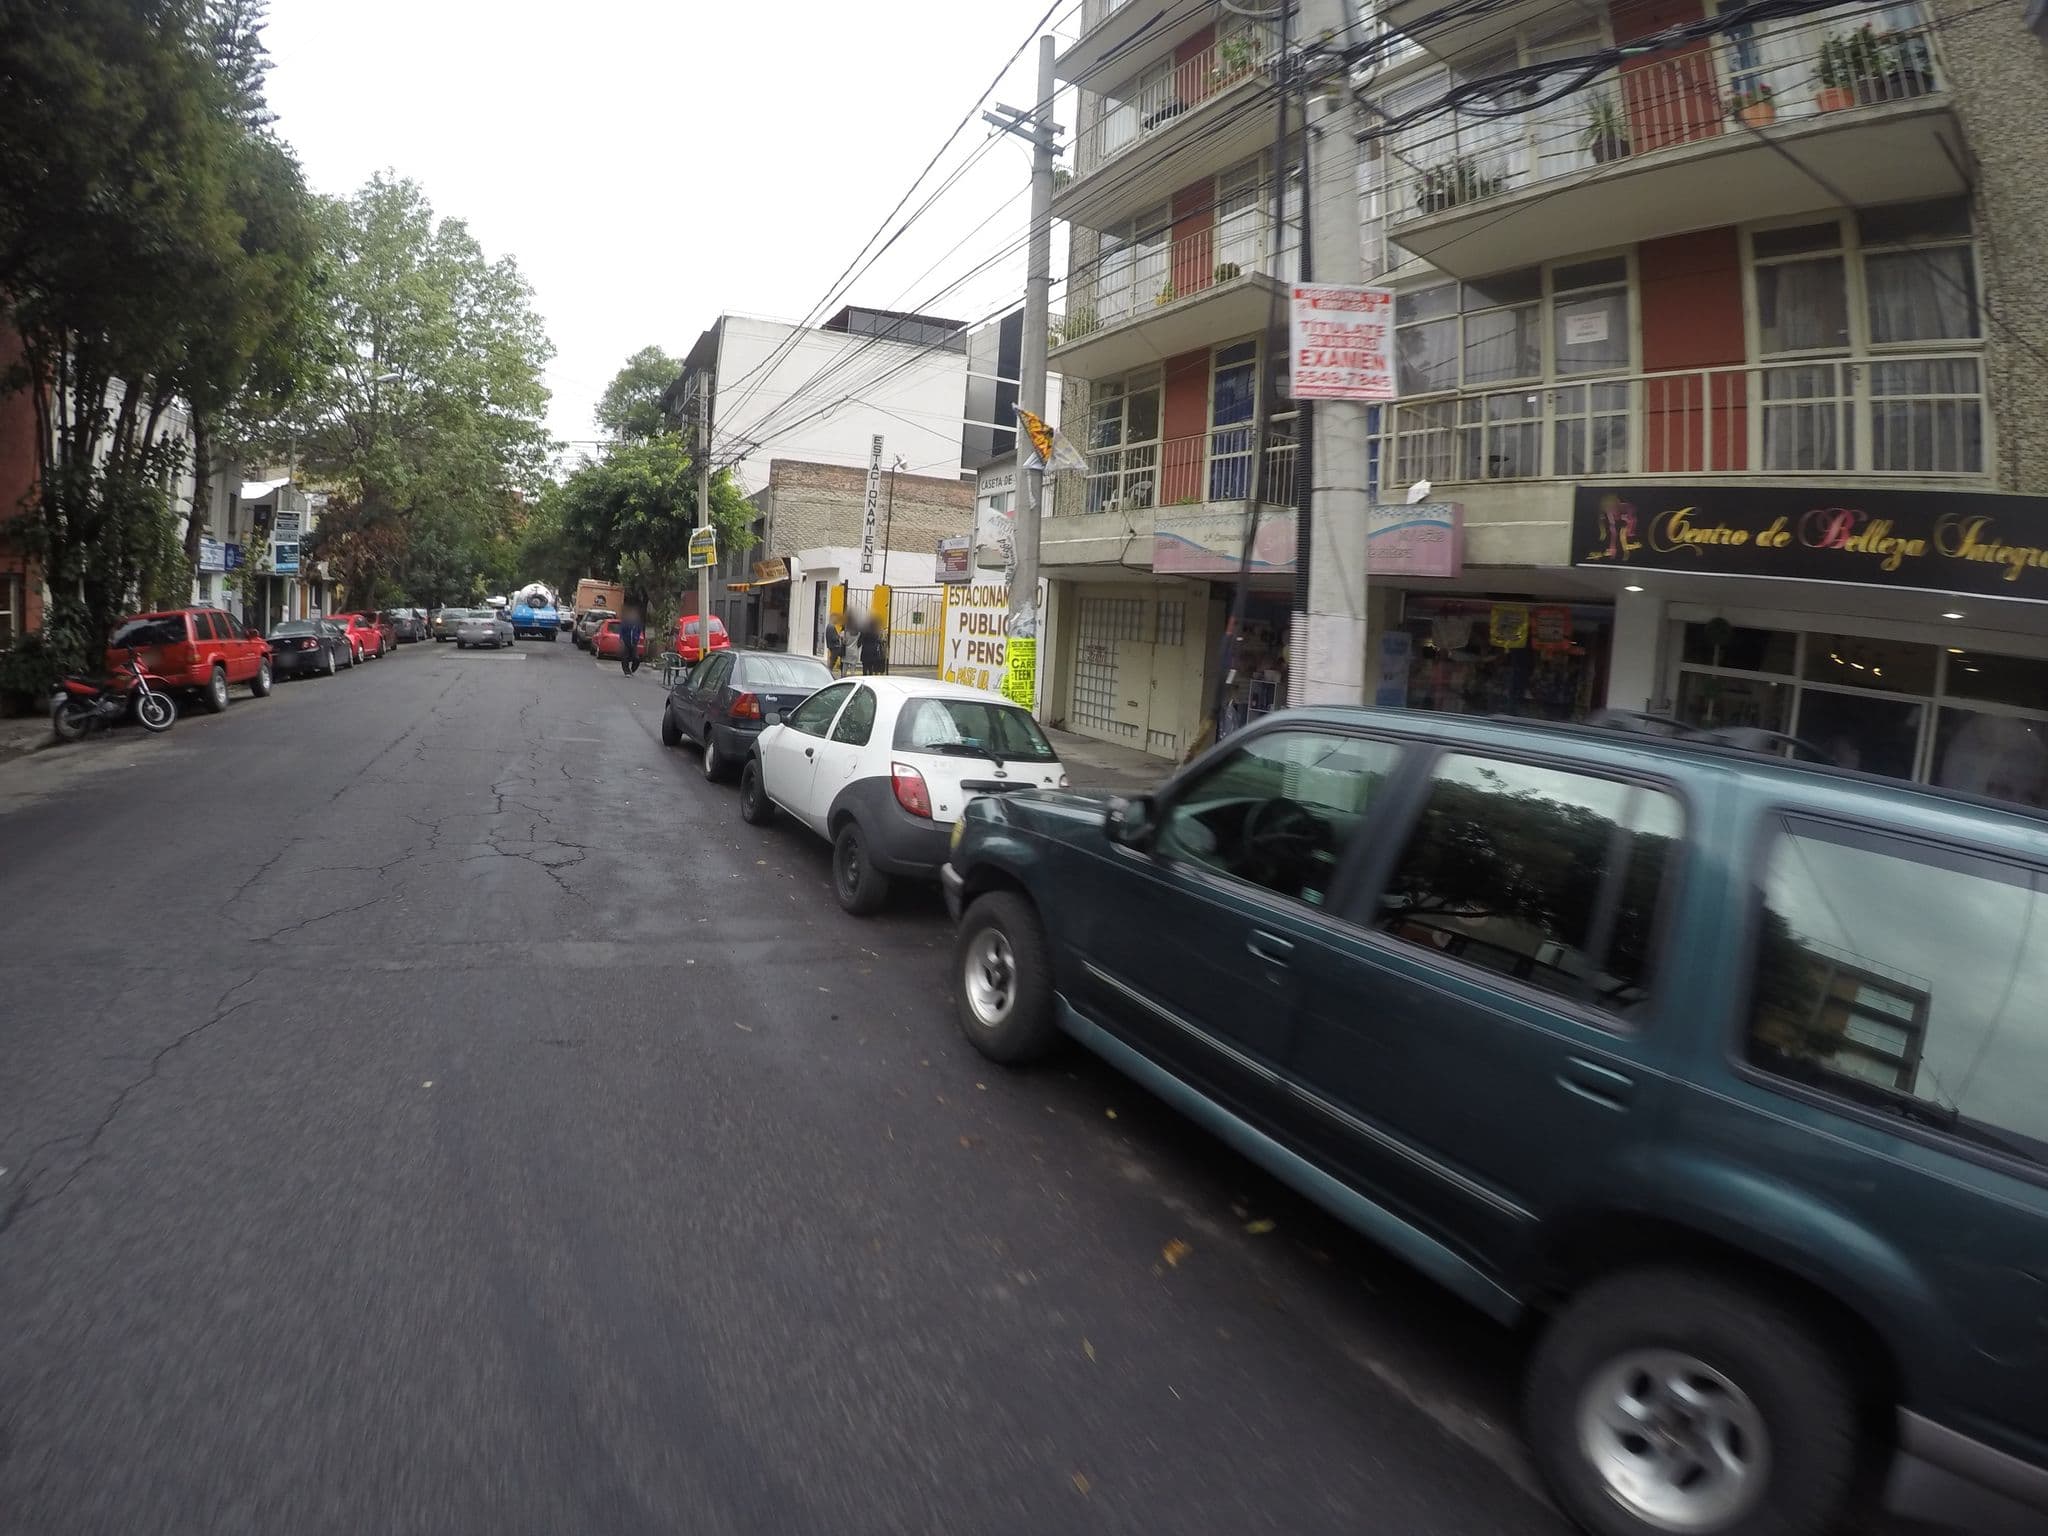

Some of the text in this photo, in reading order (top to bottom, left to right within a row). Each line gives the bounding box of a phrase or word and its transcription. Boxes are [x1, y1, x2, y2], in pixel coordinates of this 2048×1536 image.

[1299, 349, 1386, 370] EXAMEN
[862, 436, 883, 573] ESTACIONAMIENTO
[1648, 506, 1750, 557] Centro
[1755, 516, 1792, 548] de
[959, 612, 1009, 637] PUBLIC
[951, 638, 962, 659] Y
[967, 640, 1005, 666] PENS
